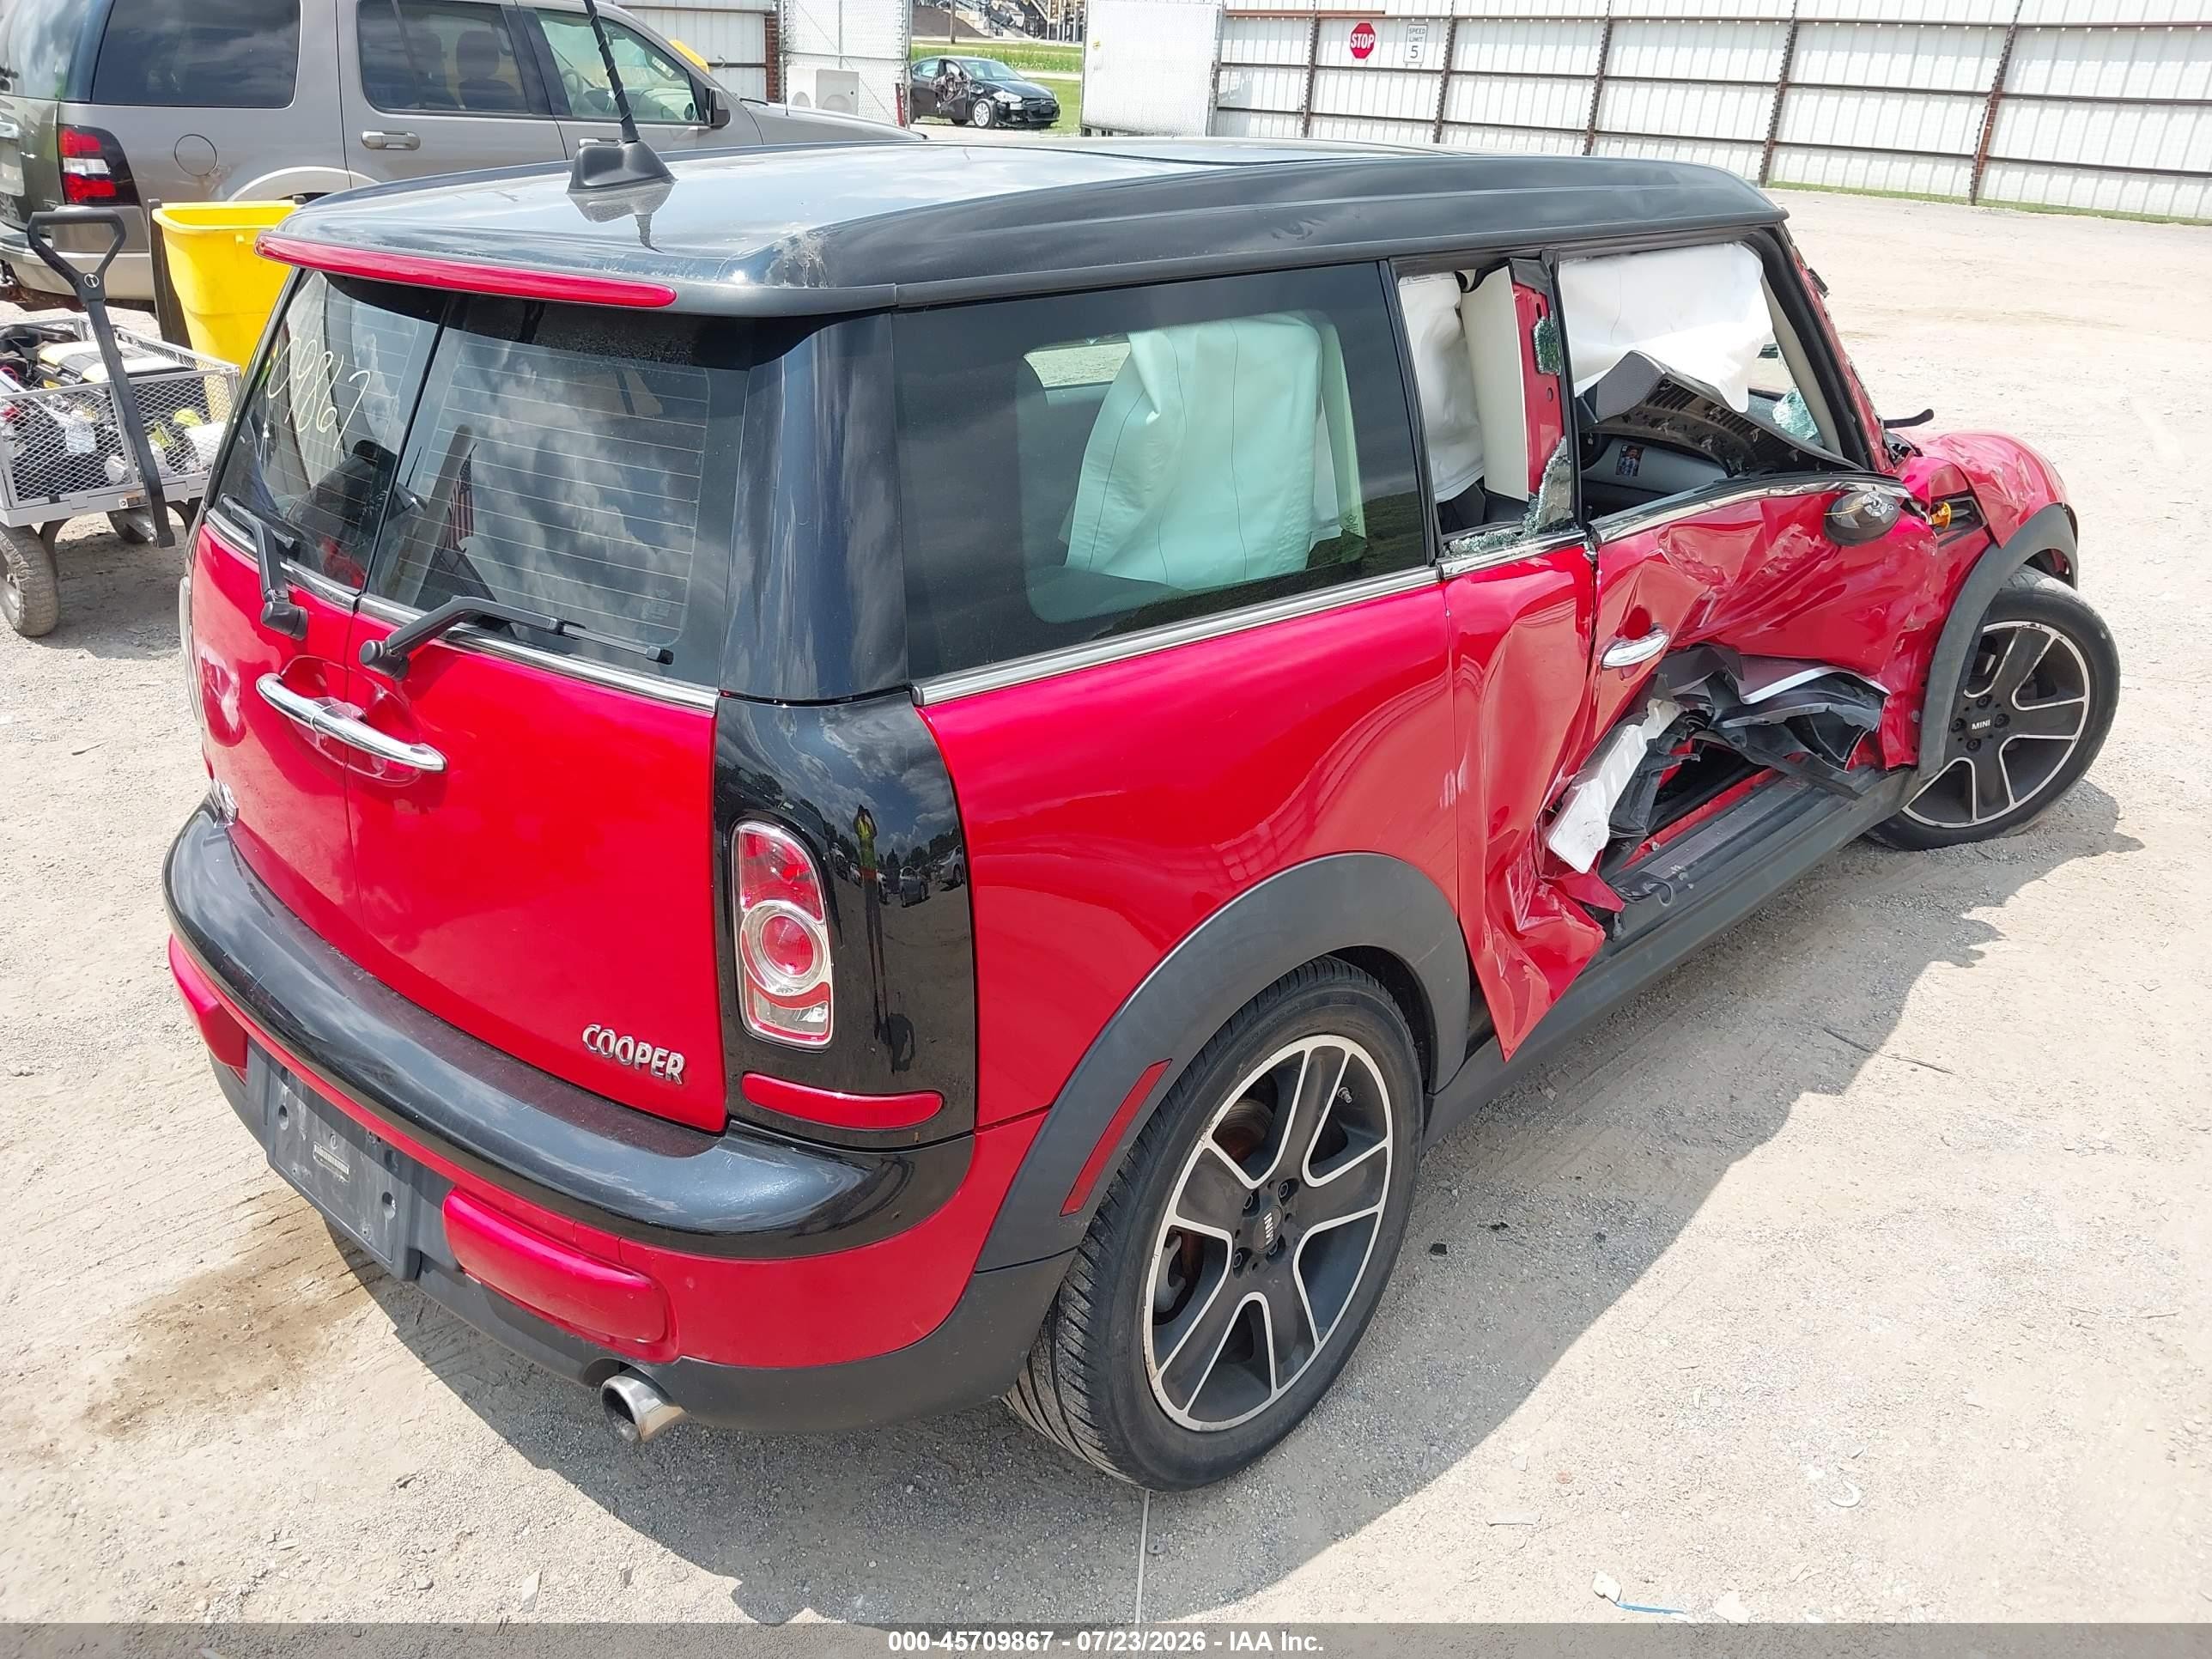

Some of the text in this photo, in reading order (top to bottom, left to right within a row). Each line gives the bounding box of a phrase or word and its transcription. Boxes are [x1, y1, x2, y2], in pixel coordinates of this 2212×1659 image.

[1351, 33, 1375, 50] STOP
[1409, 45, 1419, 59] 5
[1971, 719, 1991, 731] MINI
[581, 1023, 685, 1085] COOPER
[1263, 1212, 1274, 1246] MINI
